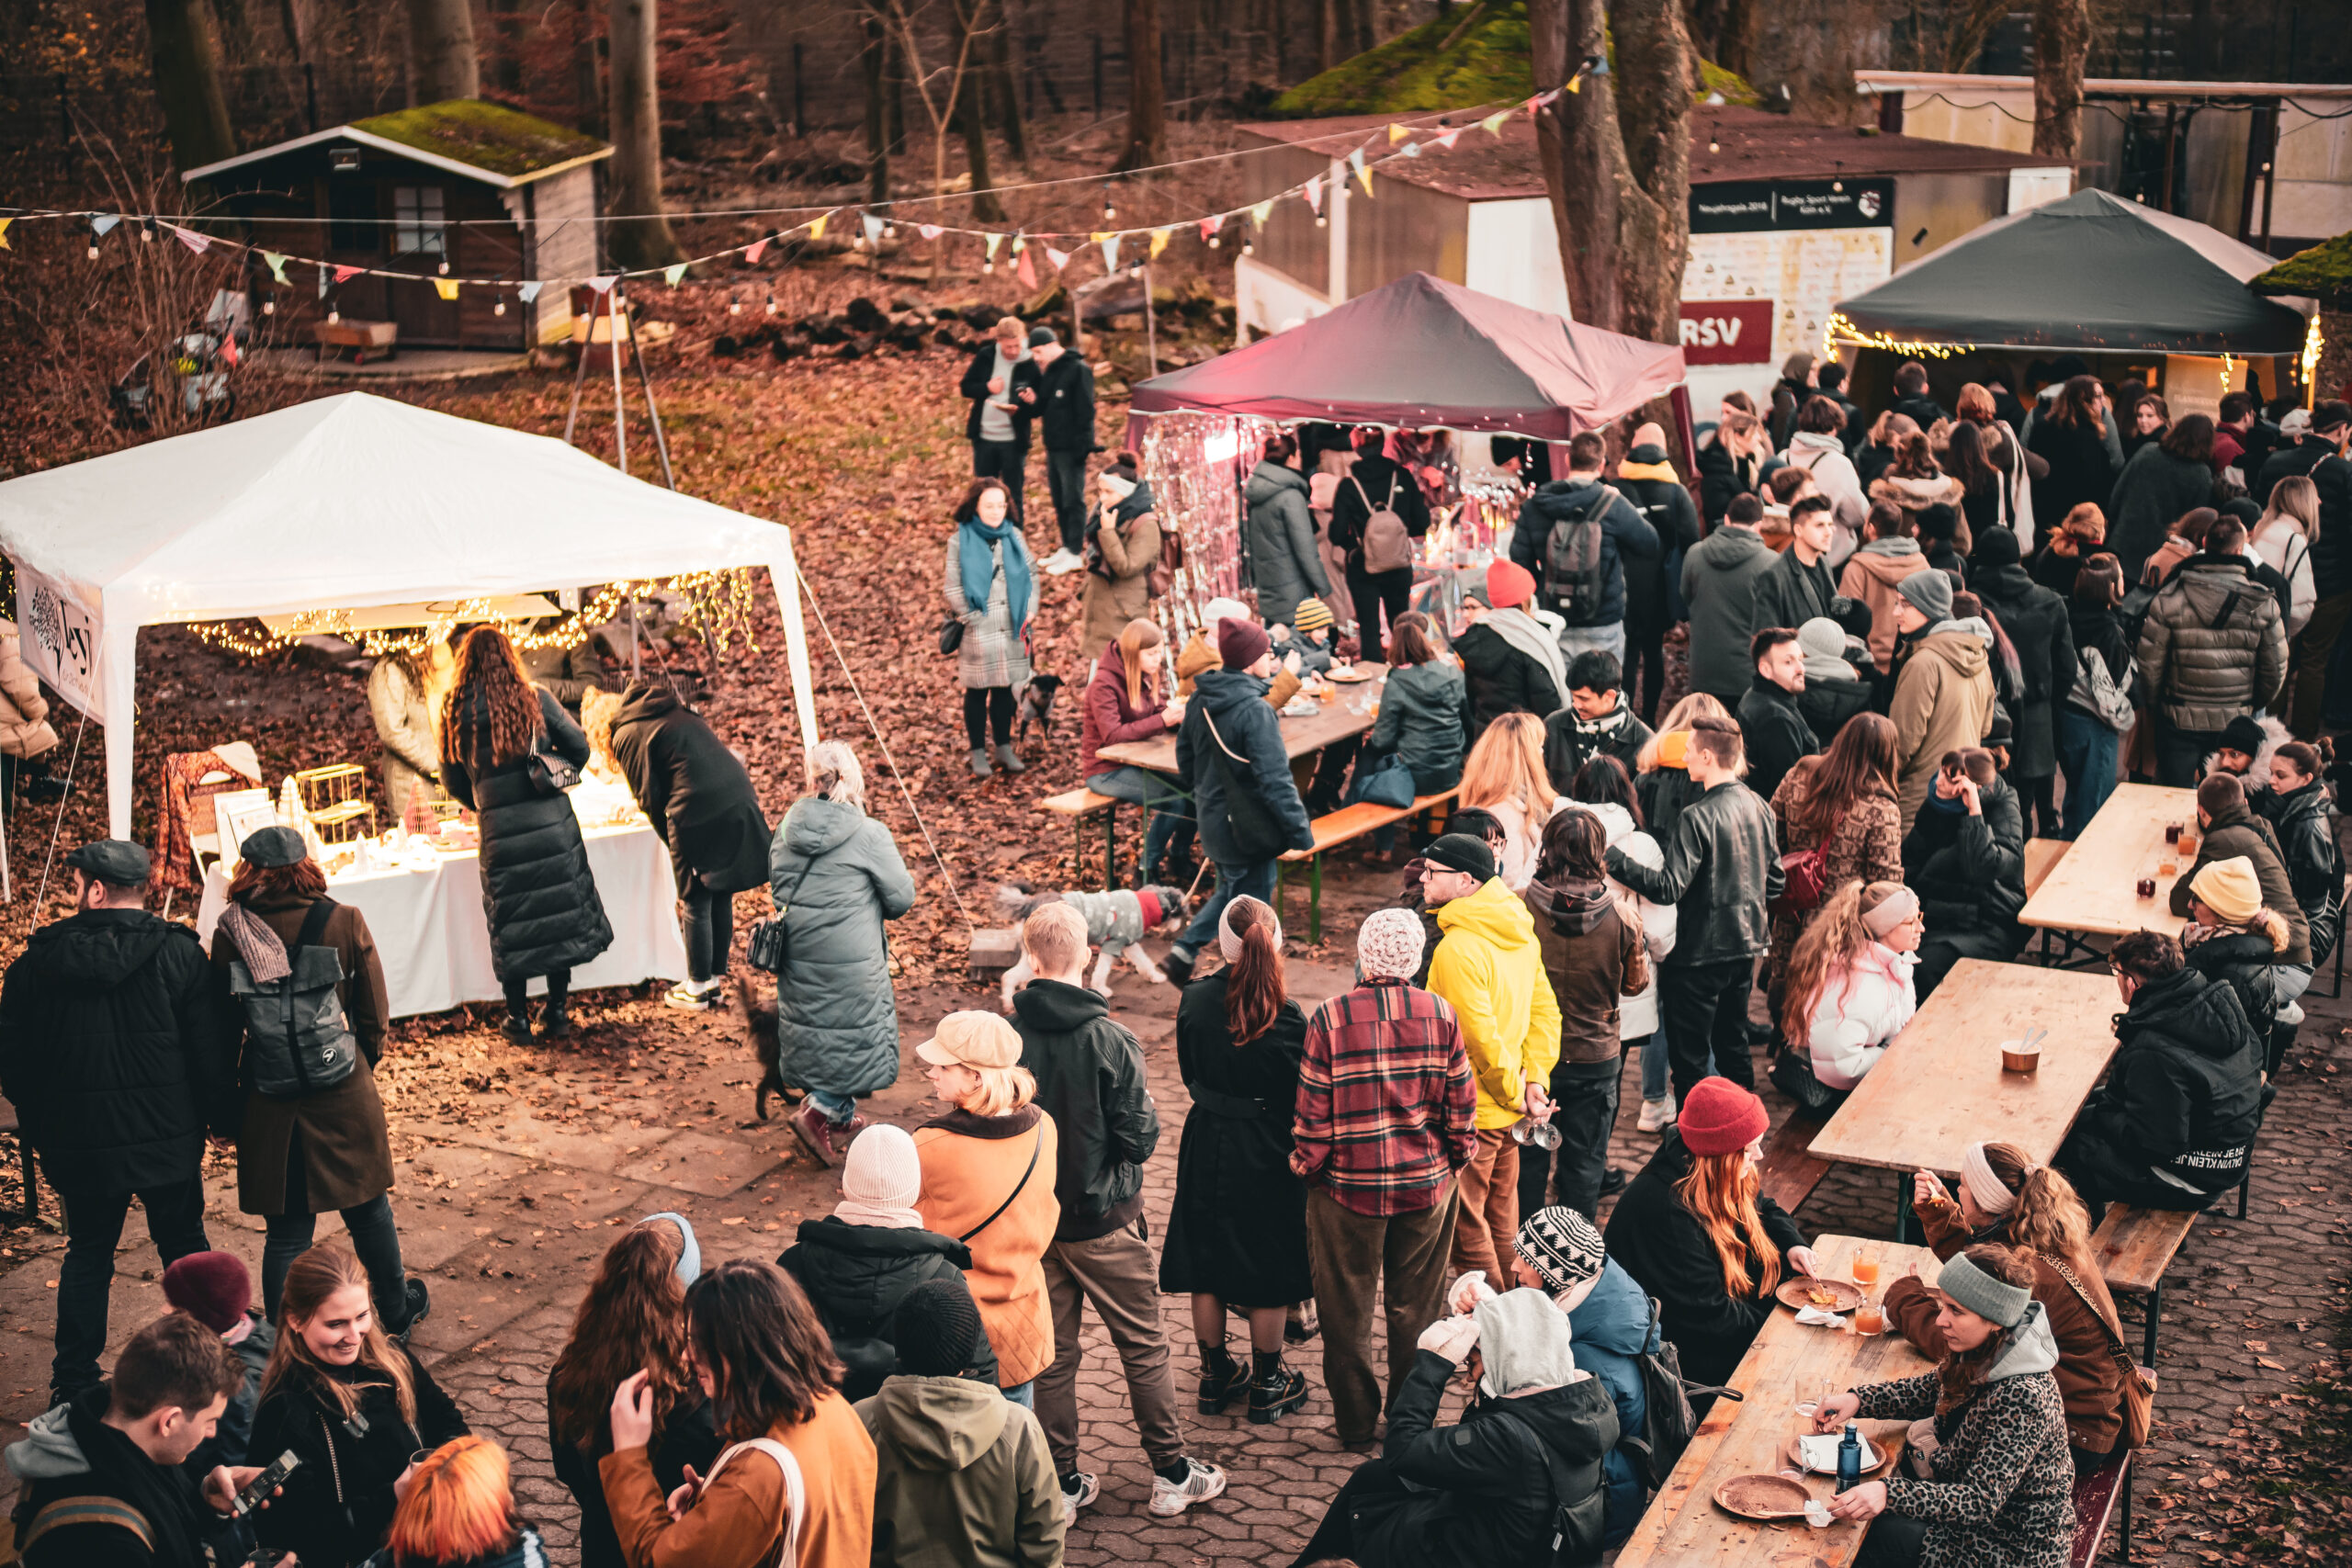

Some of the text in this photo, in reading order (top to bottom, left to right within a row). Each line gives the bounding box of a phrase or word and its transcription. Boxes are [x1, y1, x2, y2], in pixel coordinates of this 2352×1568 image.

[1679, 317, 1742, 346] RSV
[2188, 1156, 2217, 1168] KLEIN
[2217, 1156, 2243, 1168] CALVIN
